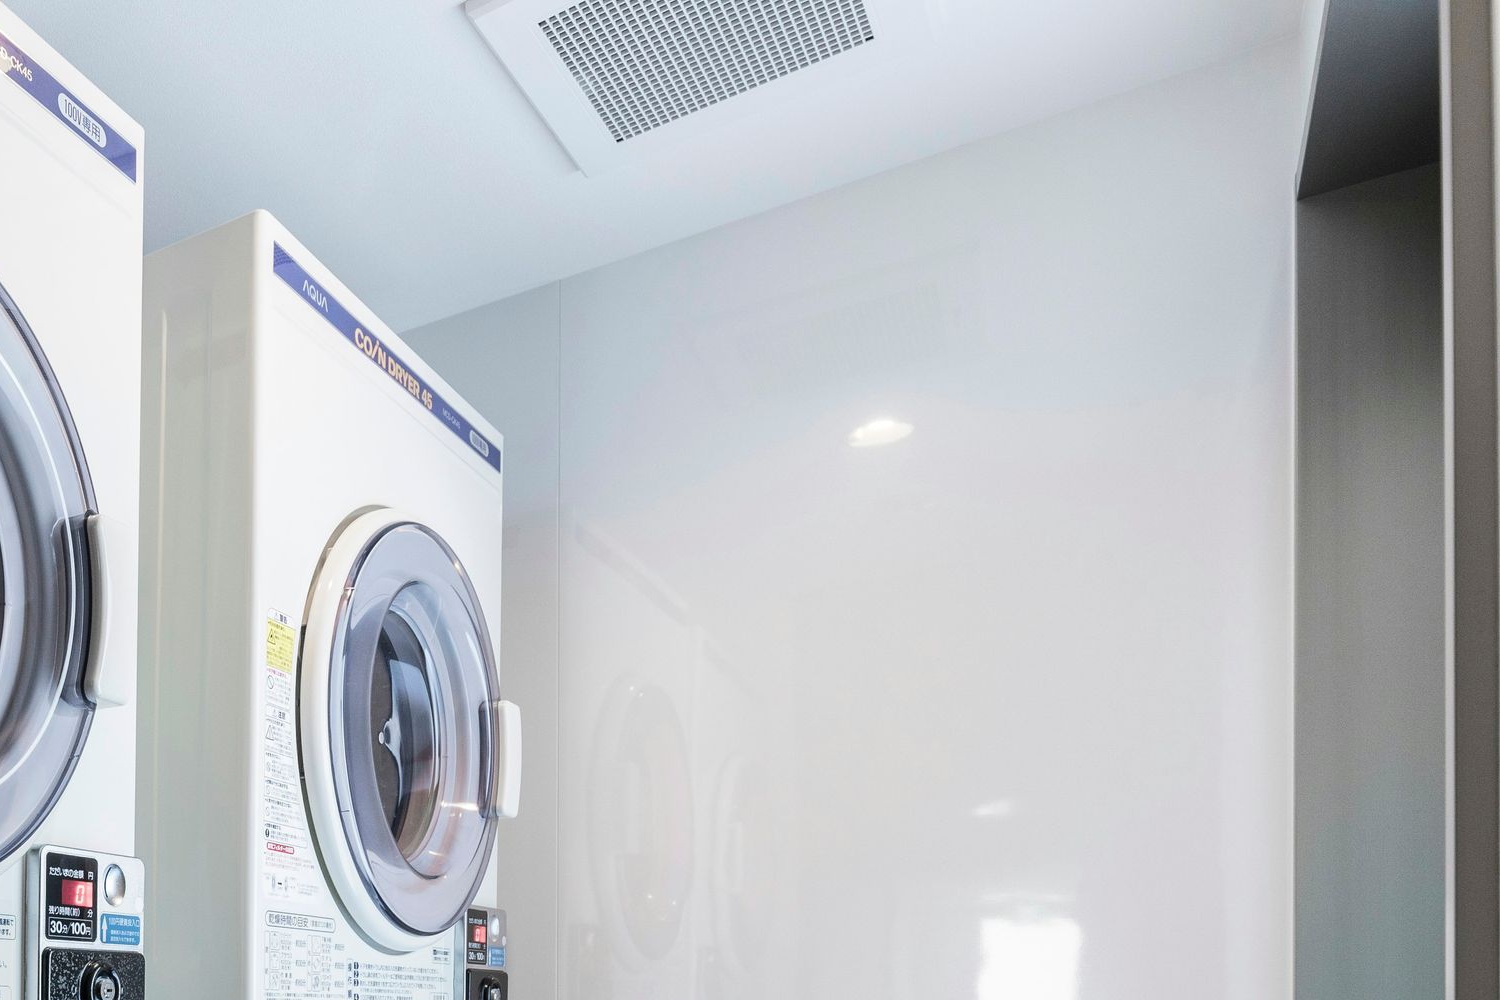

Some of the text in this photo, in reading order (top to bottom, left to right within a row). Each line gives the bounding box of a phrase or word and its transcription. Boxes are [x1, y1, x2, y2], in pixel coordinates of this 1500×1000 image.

[63, 98, 100, 142] 100V専用
[303, 280, 328, 312] AQUA
[355, 328, 432, 410] COIN DRYER 45
[50, 921, 91, 935] 30分/100円
[87, 910, 93, 918] 分
